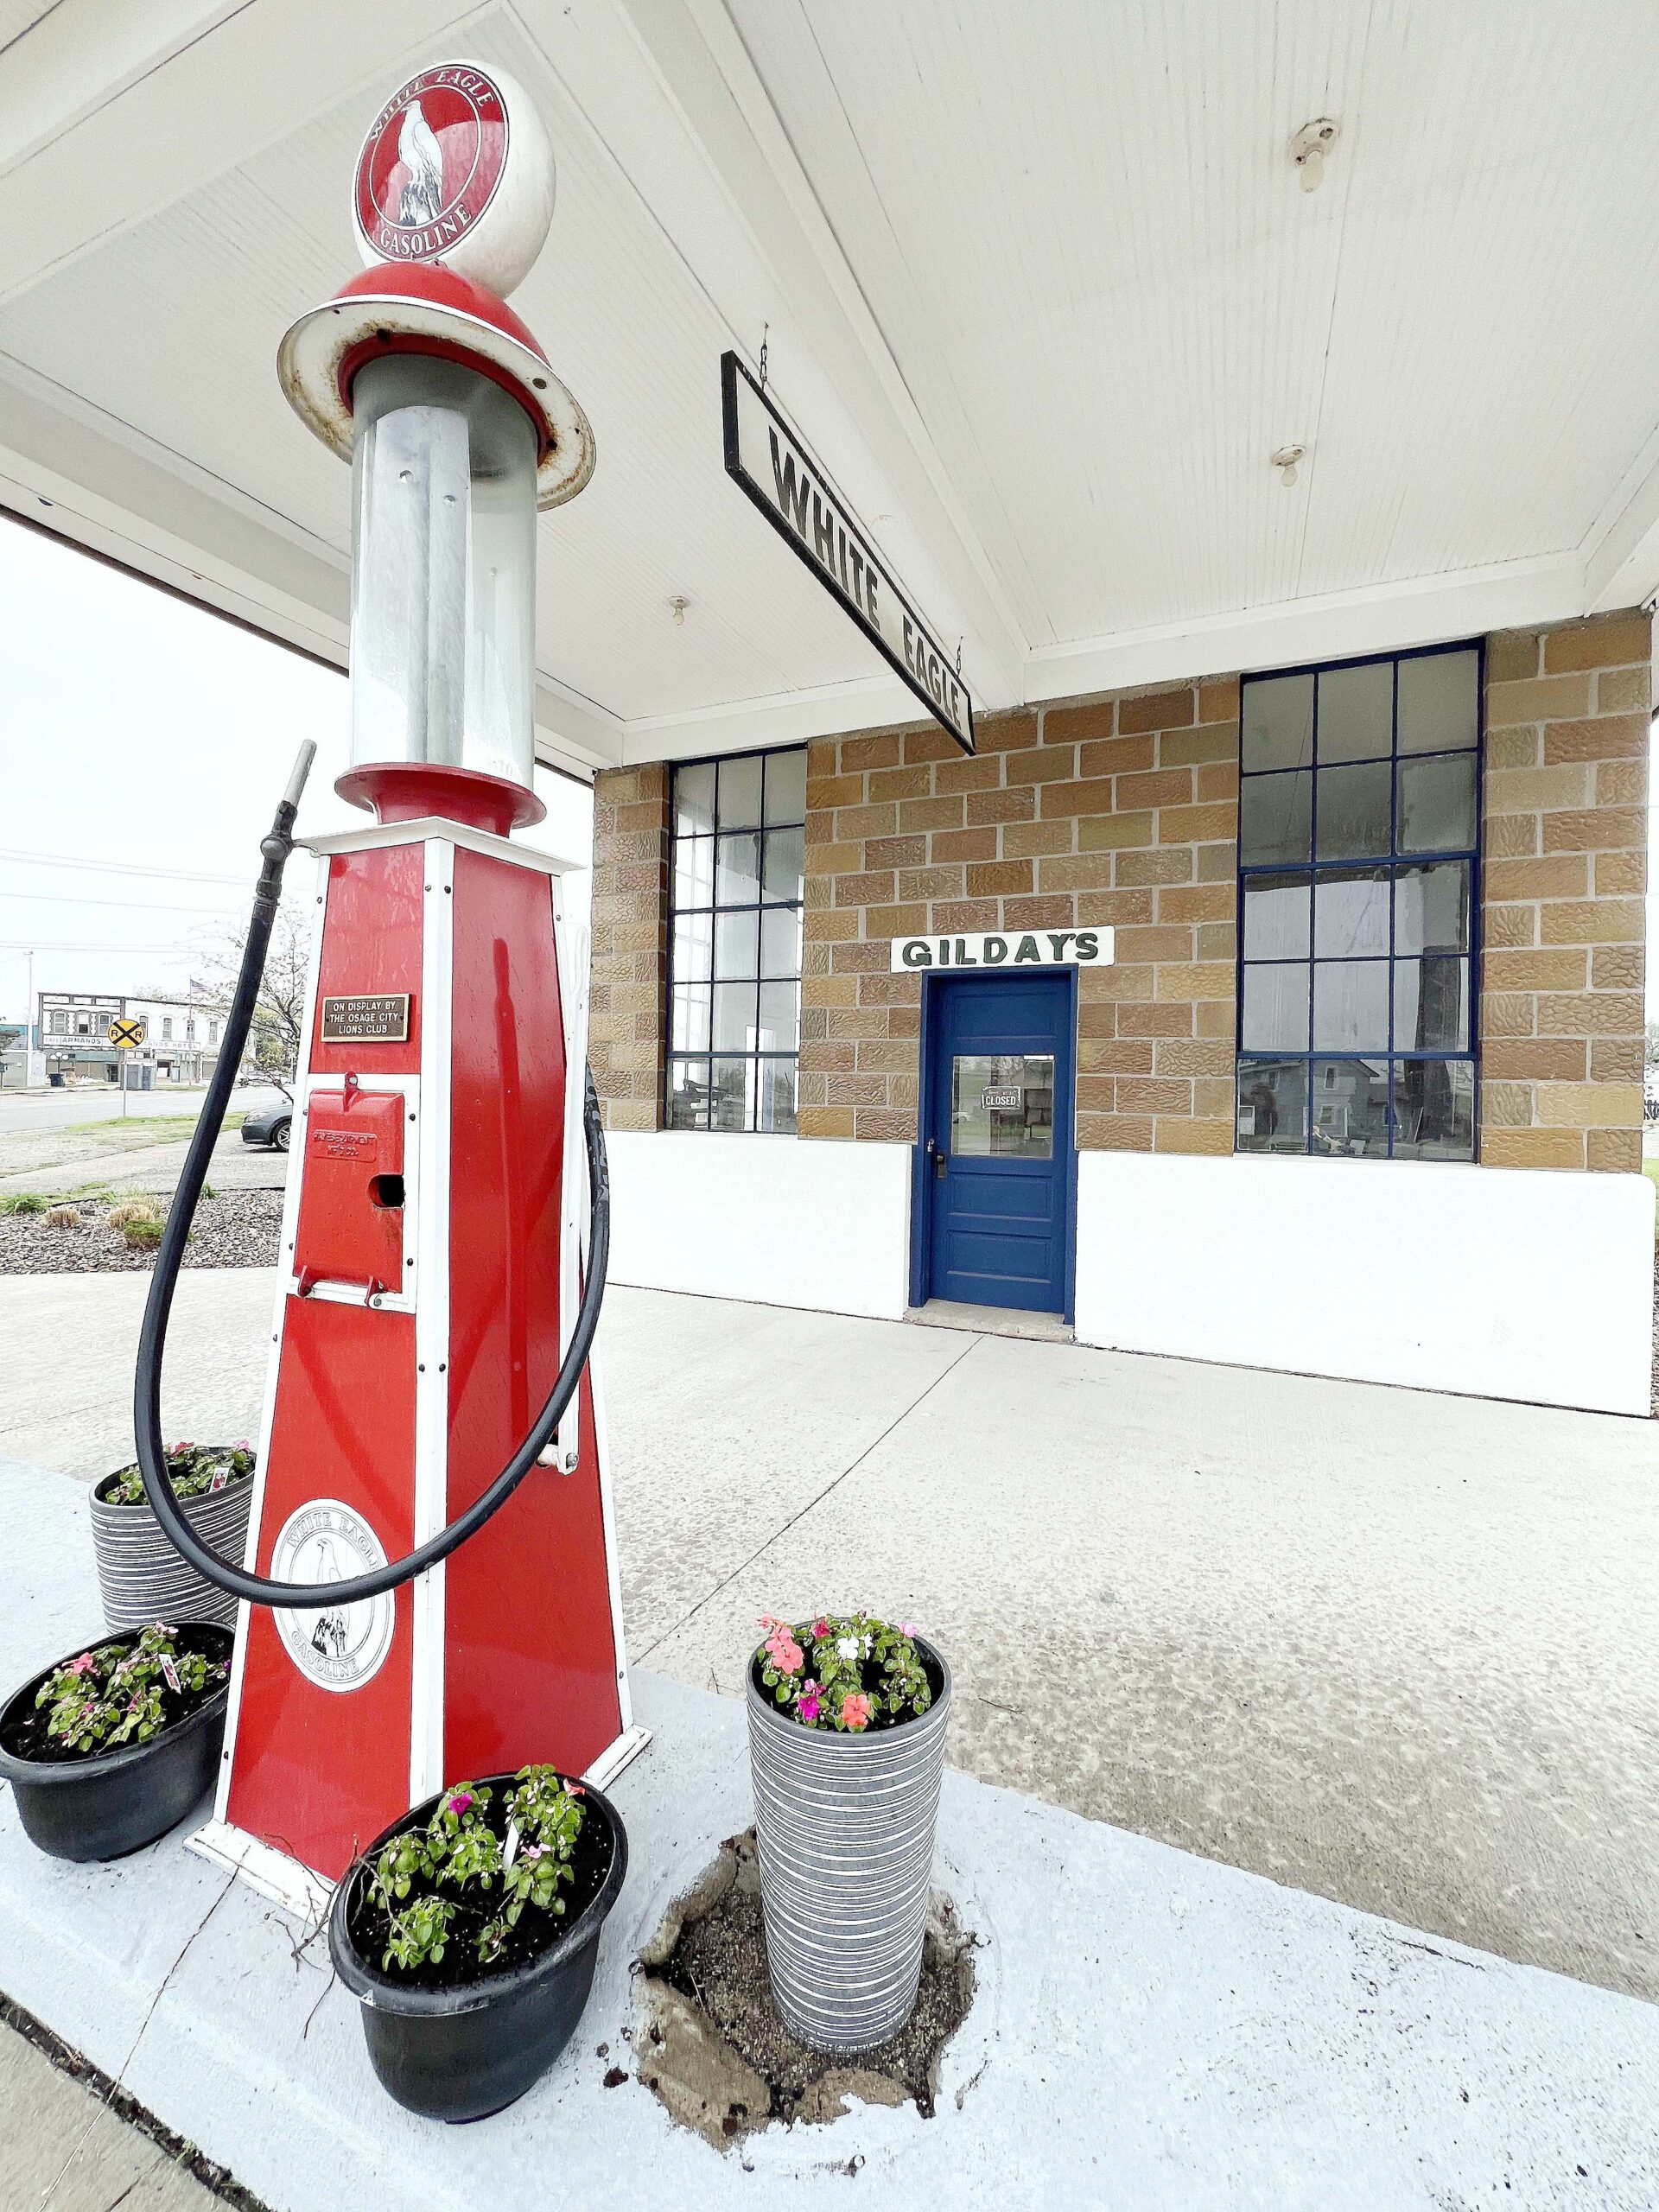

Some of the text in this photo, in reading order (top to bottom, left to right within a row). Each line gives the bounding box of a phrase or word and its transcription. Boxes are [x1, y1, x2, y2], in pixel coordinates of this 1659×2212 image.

[435, 71, 494, 107] EAGLE
[380, 203, 472, 256] GASOLINE
[768, 424, 962, 731] WHITE EAGLE
[902, 933, 1099, 967] GILDAY'S
[329, 1012, 399, 1023] THE OSAGE CITY
[333, 1001, 397, 1012] ON DISPLAY BY
[111, 1029, 118, 1038] R
[339, 1024, 388, 1034] LIONS CLUB
[61, 1036, 102, 1046] ARMANDS
[985, 1096, 1016, 1106] CLOSED
[287, 1512, 332, 1548] WHITE
[290, 1630, 359, 1678] GASOLINE
